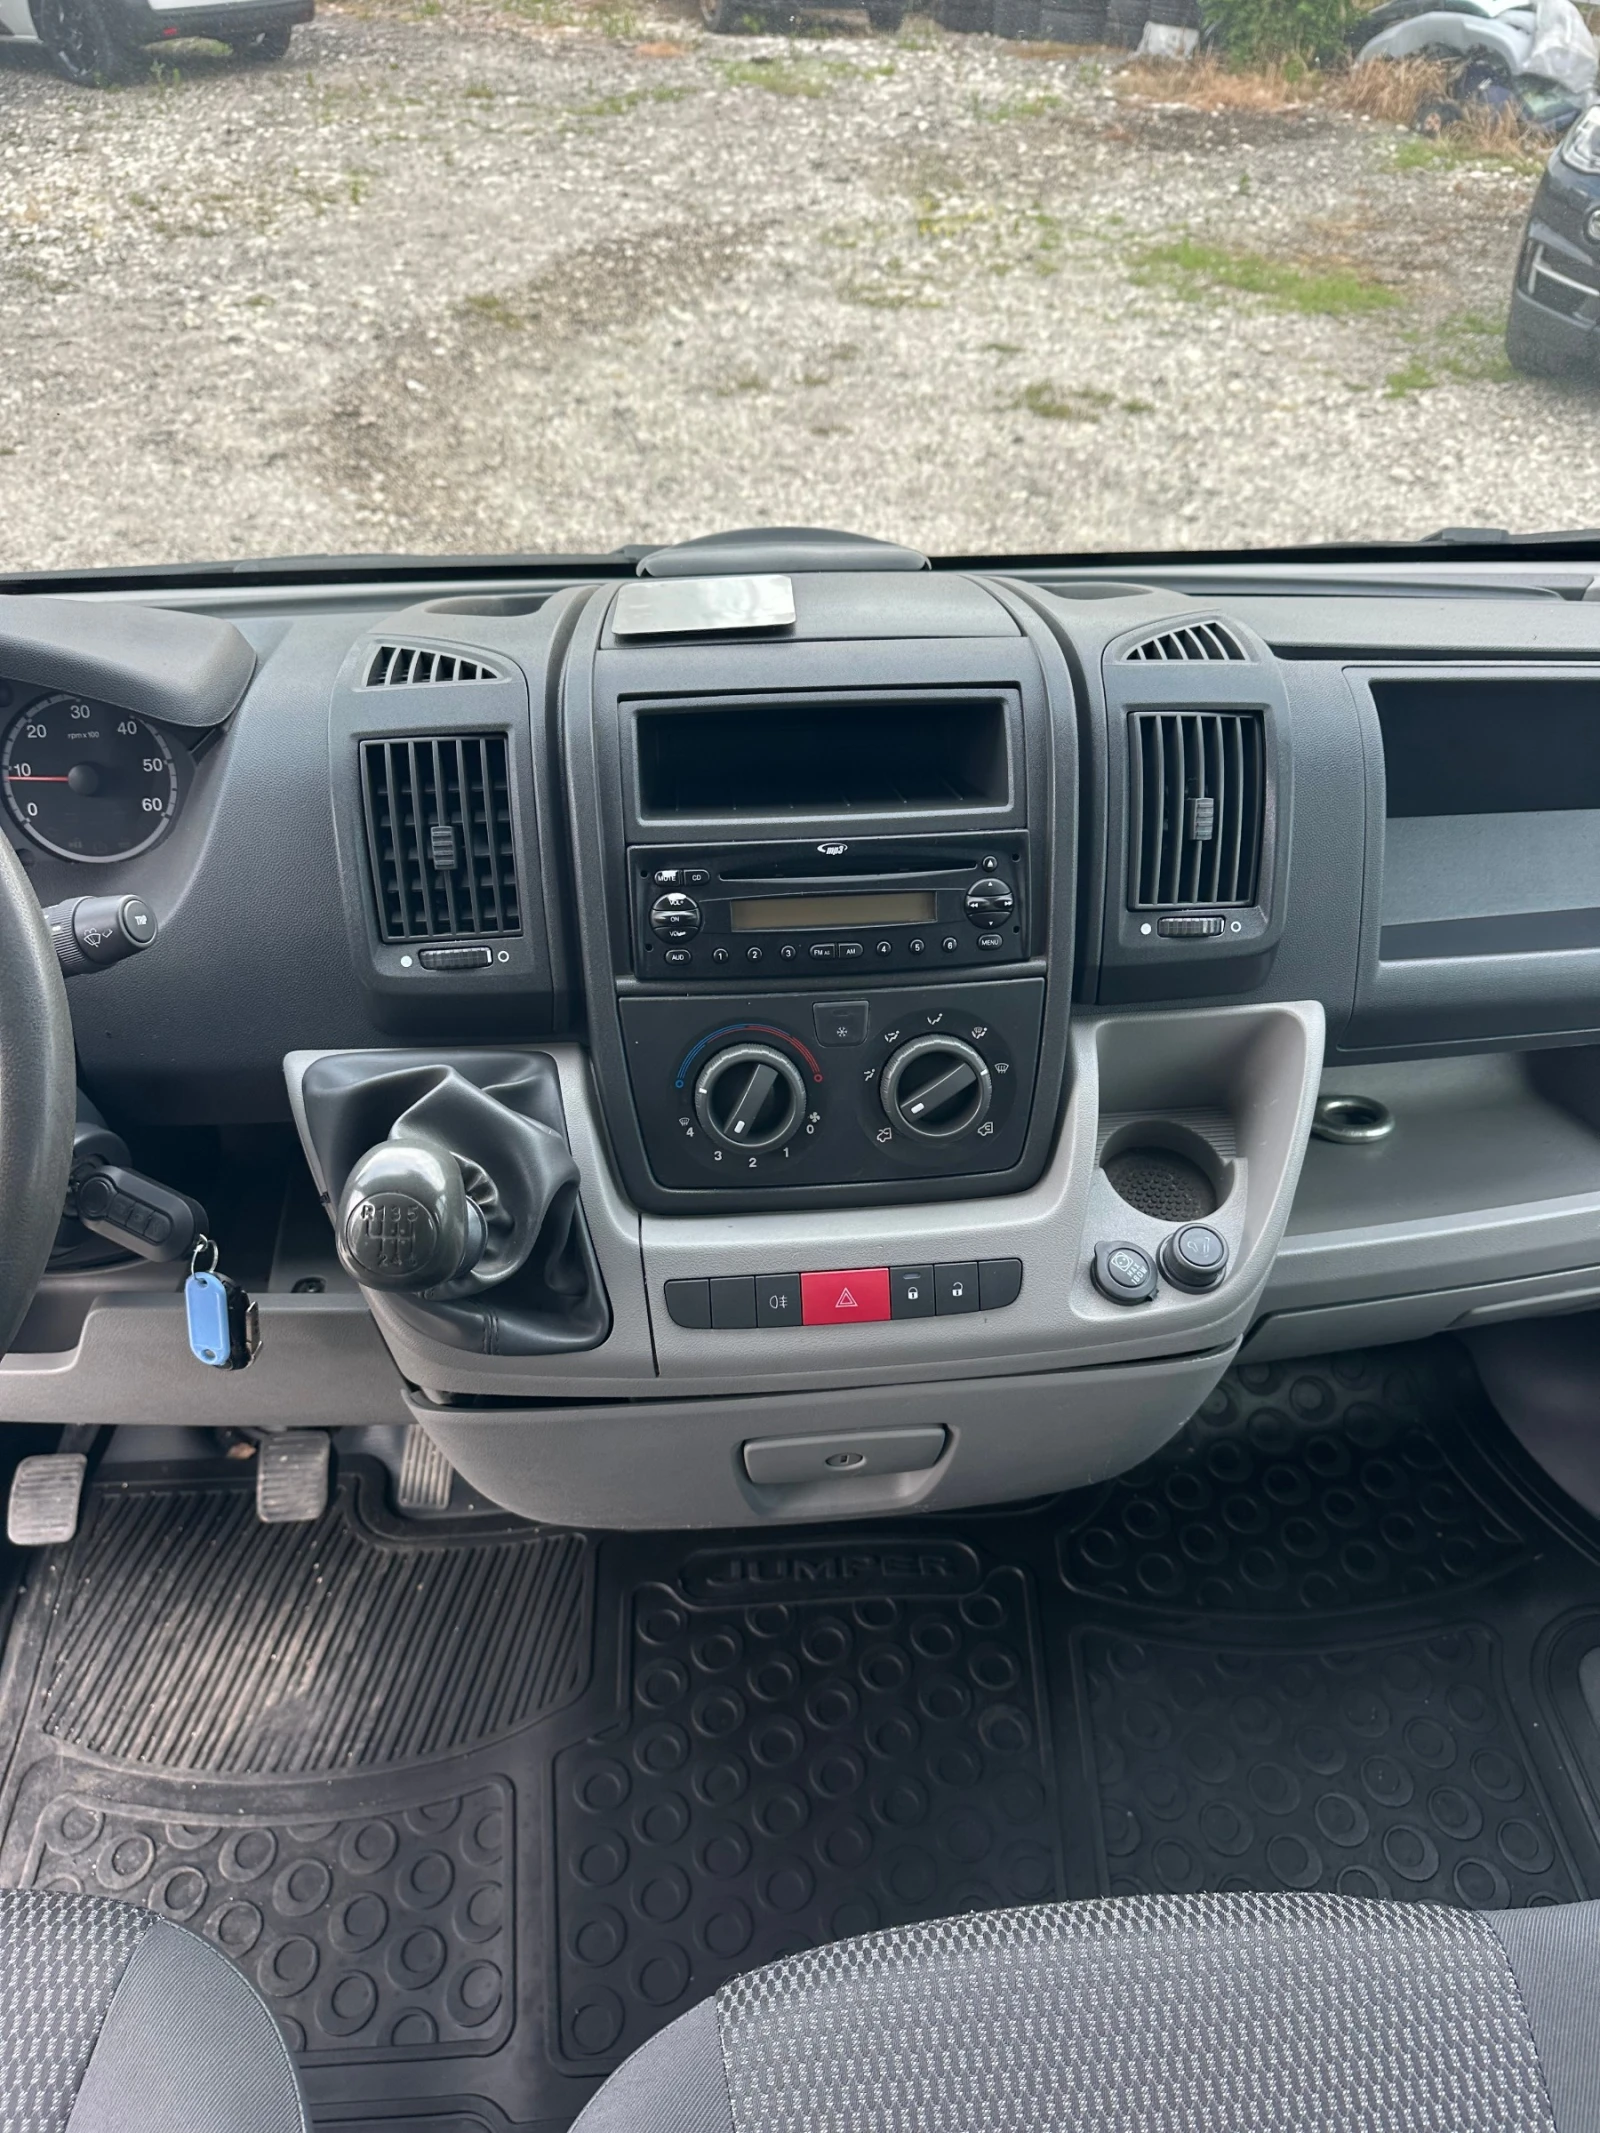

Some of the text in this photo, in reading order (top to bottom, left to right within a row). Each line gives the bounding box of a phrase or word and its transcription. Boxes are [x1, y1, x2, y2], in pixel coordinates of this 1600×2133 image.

[70, 705, 90, 719] 30
[27, 724, 47, 738] 20
[117, 721, 137, 735] 40
[14, 763, 31, 777] 10
[143, 758, 163, 772] 50
[27, 803, 38, 816] 0
[142, 798, 162, 812] 60
[826, 845, 844, 855] mp3
[881, 945, 887, 953] 4
[915, 943, 920, 951] 5
[947, 942, 953, 950] 6
[752, 951, 758, 959] 2
[686, 1127, 695, 1137] 4
[806, 1124, 814, 1134] 0
[713, 1151, 723, 1161] 3
[783, 1148, 790, 1157] 1
[748, 1158, 757, 1168] 2
[1127, 1262, 1141, 1277] MAX
[1131, 1265, 1148, 1285] 180W
[706, 1555, 951, 1586] JUMPER
